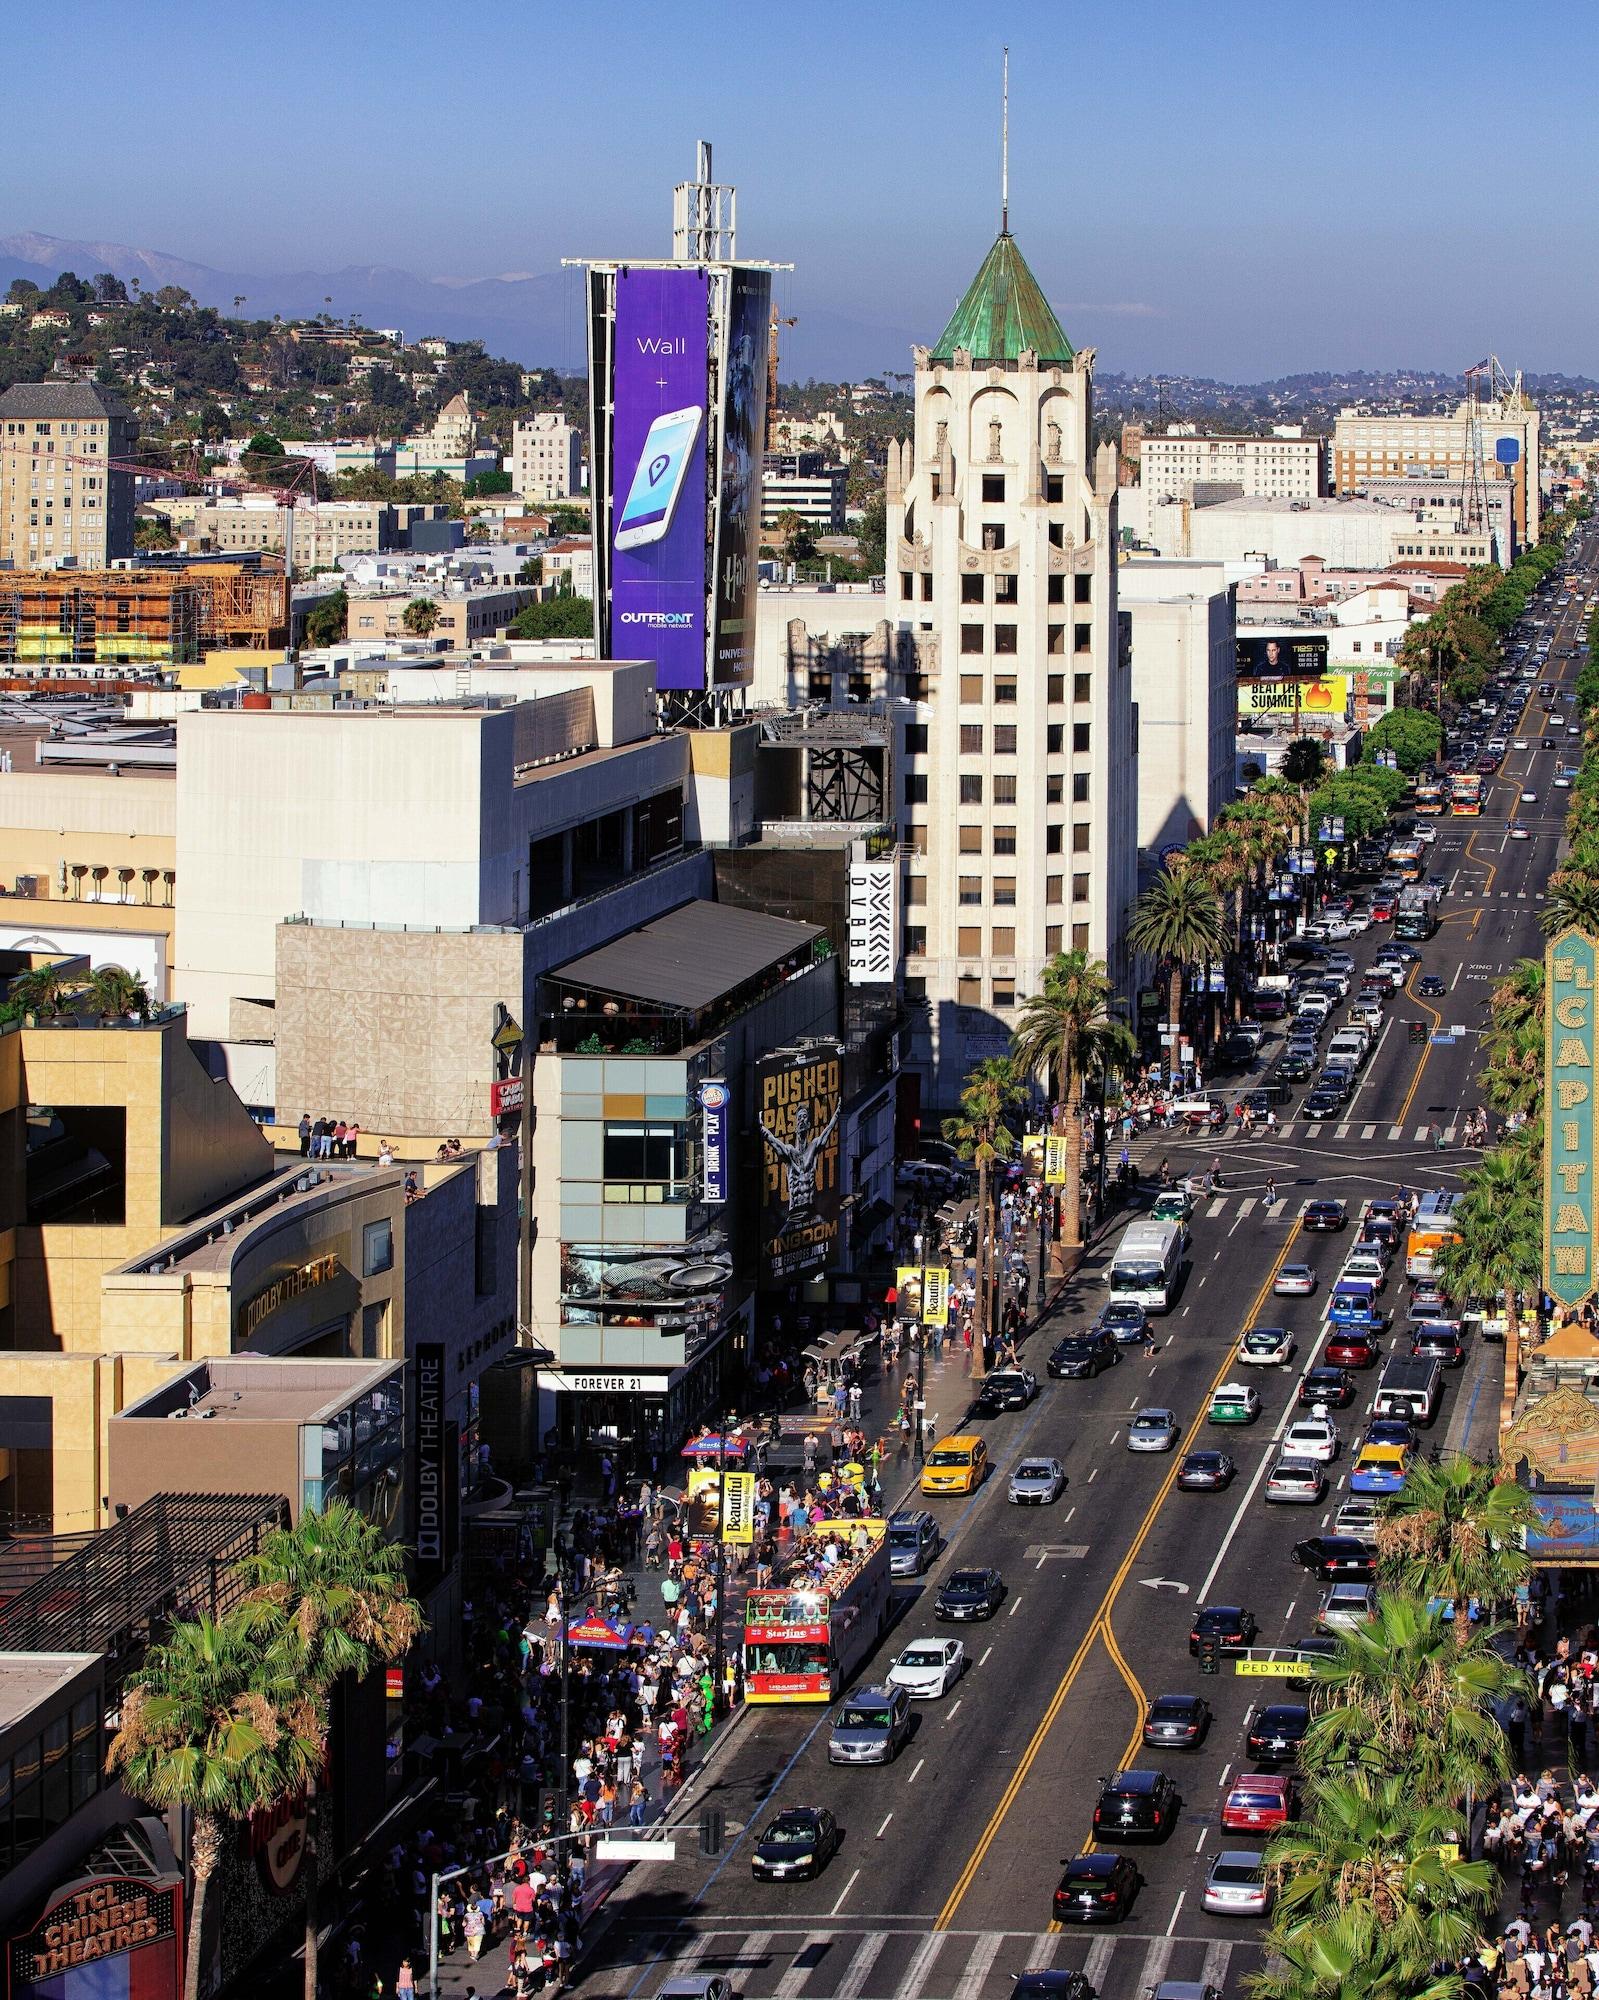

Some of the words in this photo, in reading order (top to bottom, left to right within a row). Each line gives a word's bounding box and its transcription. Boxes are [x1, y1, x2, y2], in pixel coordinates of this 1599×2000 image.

[637, 338, 684, 354] Wall
[621, 612, 694, 624] OUTFRONT
[1251, 695, 1302, 708] SUMMER
[1252, 683, 1276, 693] BEAT
[851, 877, 866, 968] DVBBS
[1563, 941, 1585, 956] The
[1553, 957, 1594, 990] EL
[763, 1060, 839, 1110] PUSHED
[708, 1113, 719, 1135] PLAY
[1553, 995, 1590, 1275] CAPITAN
[708, 1145, 719, 1173] DRINK
[1048, 1139, 1059, 1176] Beautiful
[709, 1183, 720, 1199] EAT
[763, 1219, 839, 1258] KINGDOM
[810, 1242, 825, 1257] JUNE
[255, 1281, 282, 1325] DOLBY
[284, 1252, 340, 1298] THEATRE
[926, 1271, 939, 1316] Beautiful
[458, 1314, 515, 1371] SEPHORA
[574, 1378, 625, 1390] FOREVER
[630, 1378, 641, 1390] 21
[420, 1358, 438, 1452] THEATRE
[419, 1457, 438, 1528] DOLBY
[727, 1477, 742, 1532] Beautiful
[765, 1628, 807, 1639] Starline
[1242, 1664, 1268, 1672] PED
[1274, 1665, 1304, 1673] XING
[74, 1885, 119, 1916] TCL
[45, 1896, 148, 1947] CHINESE
[32, 1916, 158, 1977] THEATRES
